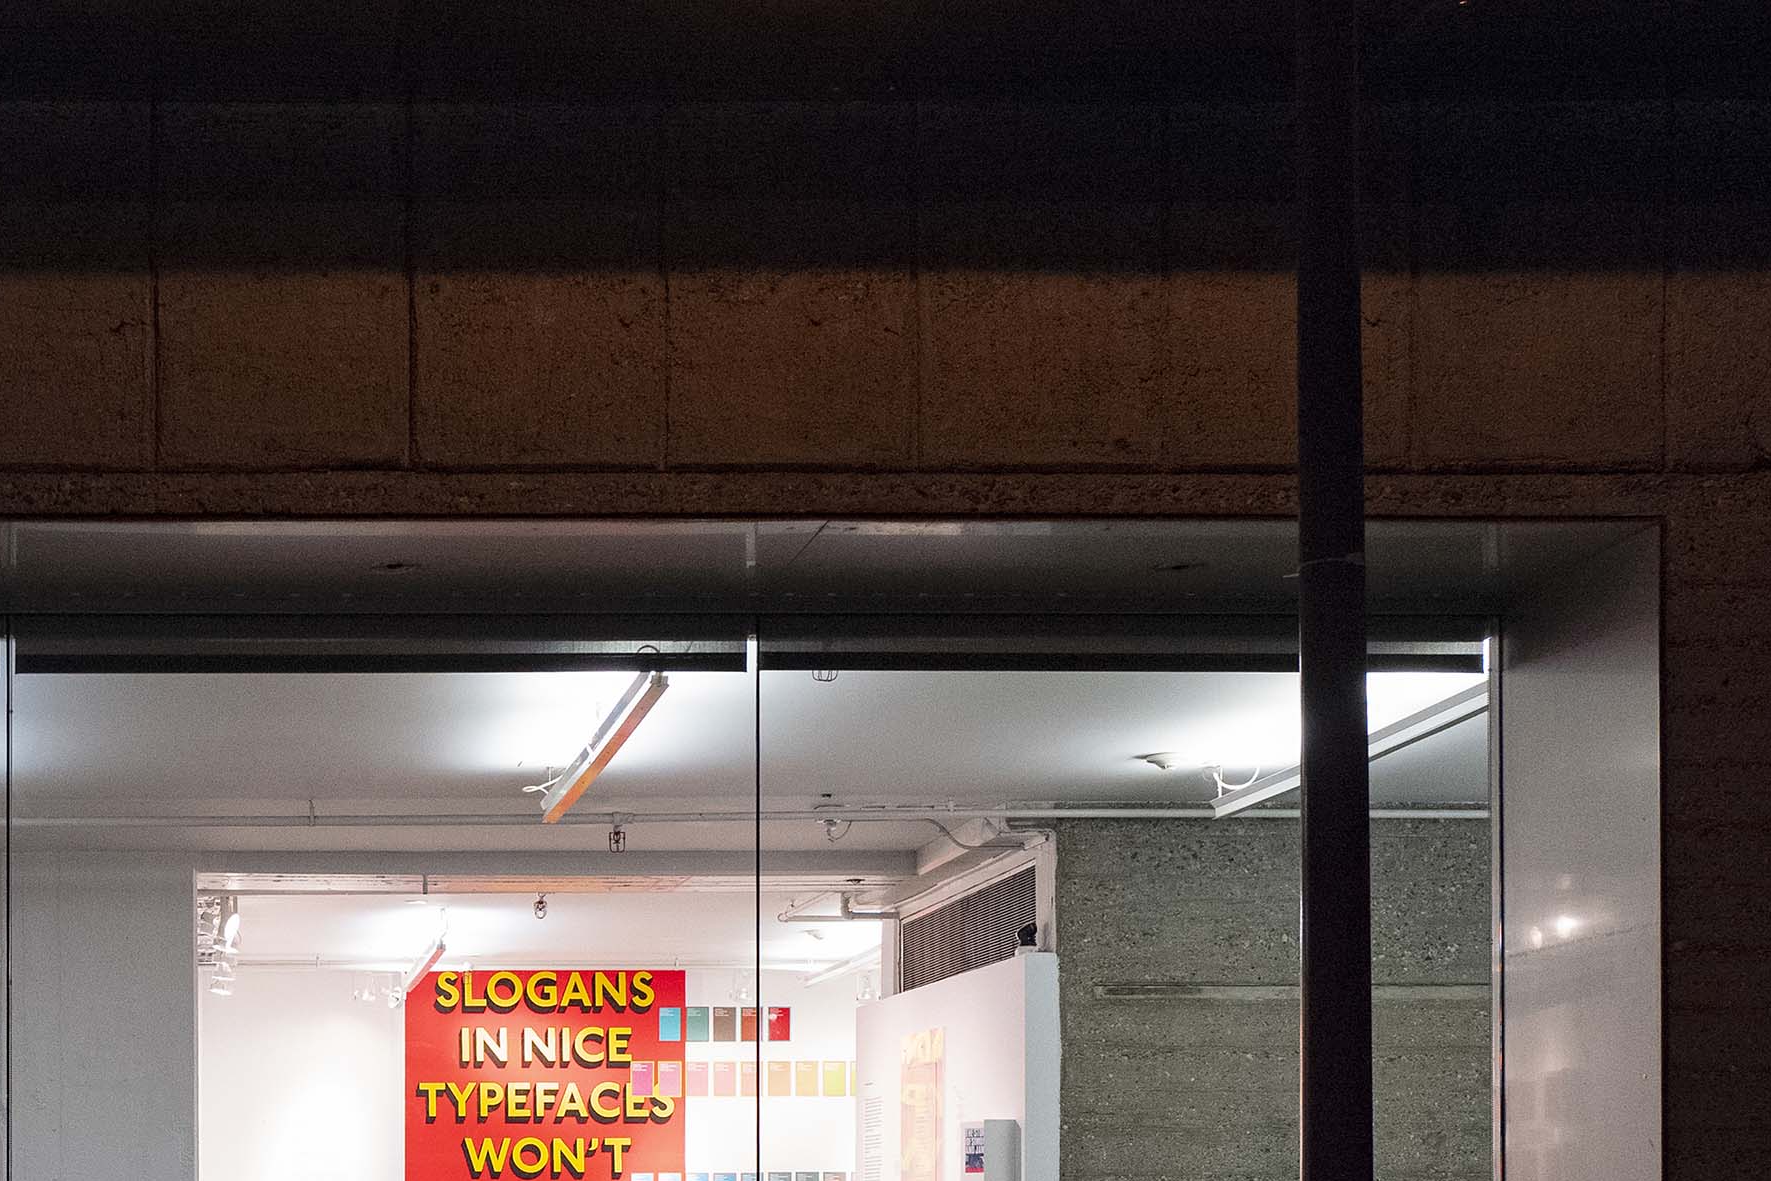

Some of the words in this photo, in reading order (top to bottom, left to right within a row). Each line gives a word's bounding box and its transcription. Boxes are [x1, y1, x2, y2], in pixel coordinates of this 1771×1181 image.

[435, 971, 655, 1013] SLOGANS
[459, 1027, 508, 1068] IN
[522, 1027, 633, 1068] NICE
[416, 1082, 675, 1124] TYPEFACES
